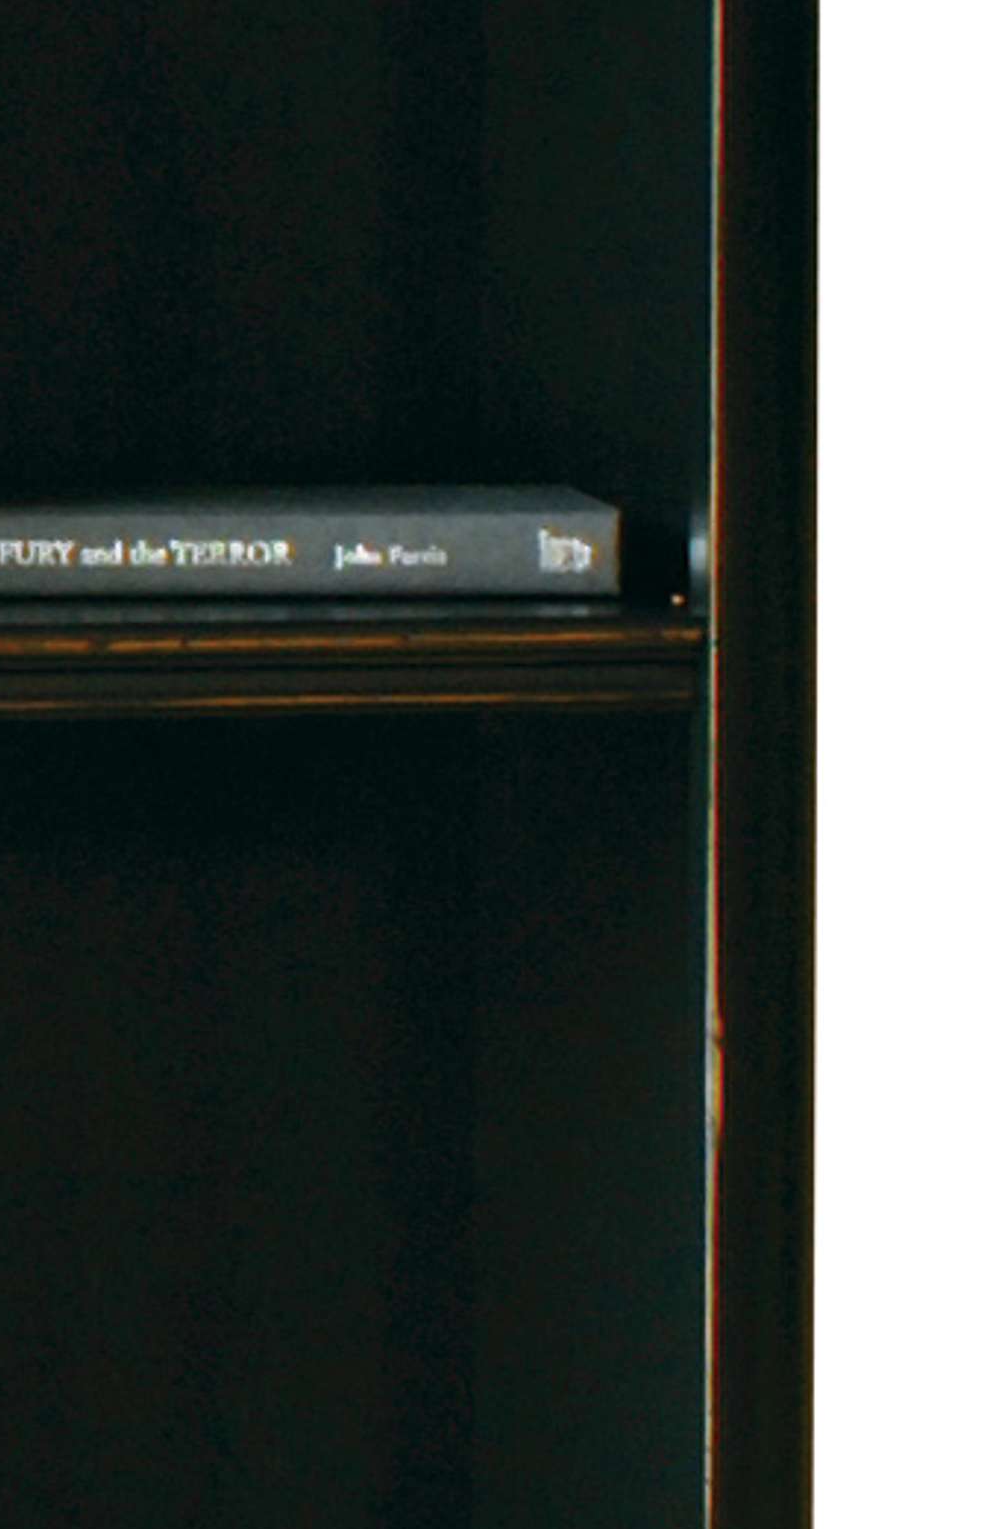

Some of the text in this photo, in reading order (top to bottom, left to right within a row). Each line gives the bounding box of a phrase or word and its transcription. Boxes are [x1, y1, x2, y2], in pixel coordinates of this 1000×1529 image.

[80, 538, 123, 566] and
[129, 538, 168, 566] the
[170, 538, 294, 566] TERROR
[333, 542, 383, 571] John
